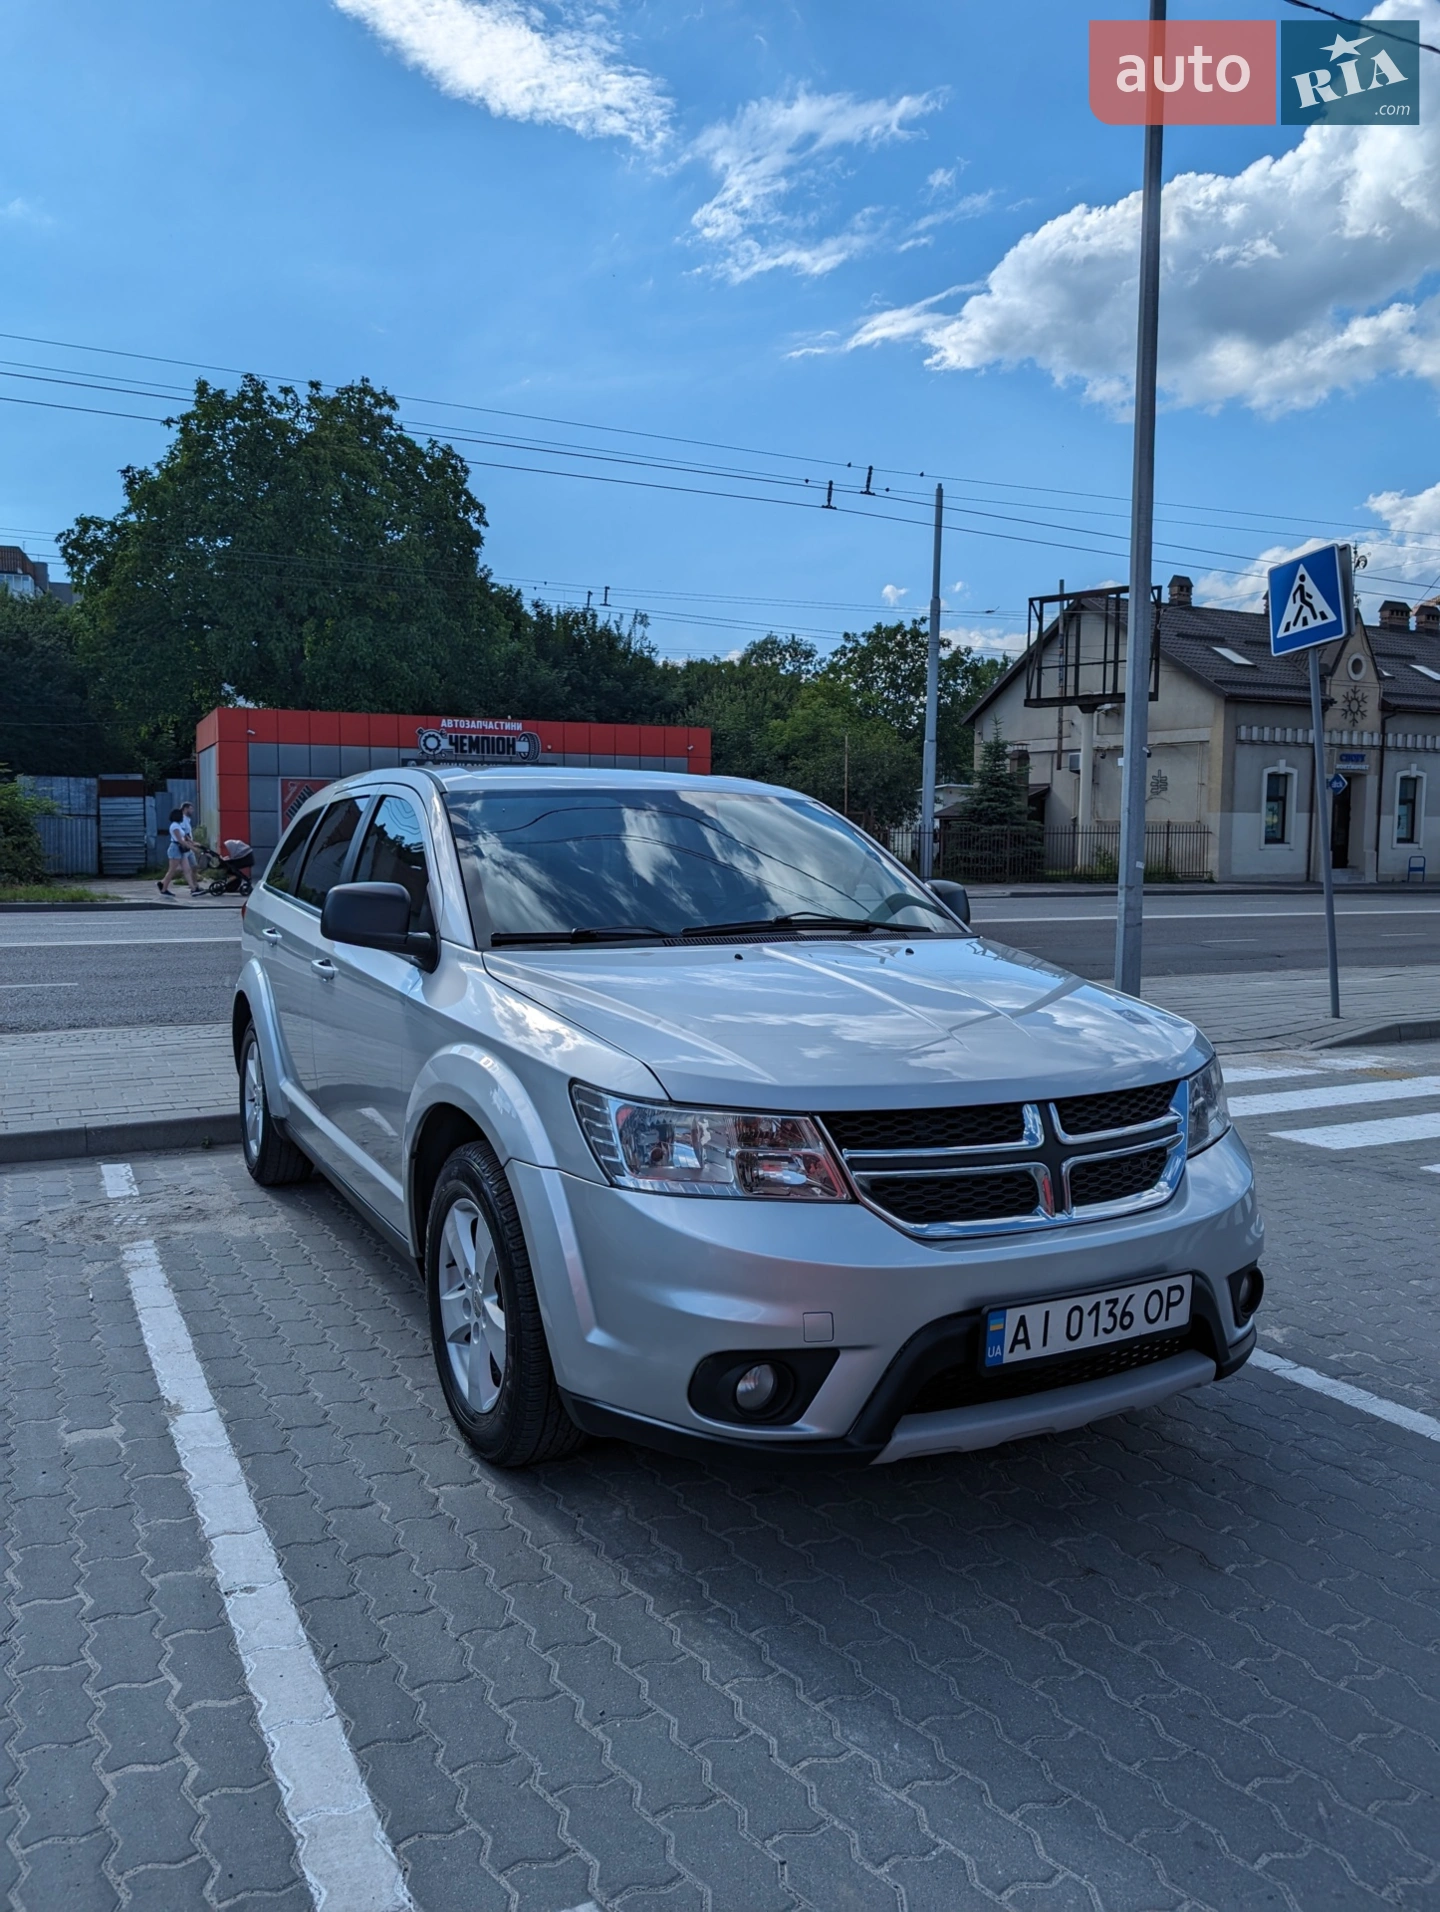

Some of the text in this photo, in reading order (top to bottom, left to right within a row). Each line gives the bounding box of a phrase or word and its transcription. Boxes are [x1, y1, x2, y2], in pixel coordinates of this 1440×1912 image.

[440, 718, 523, 731] АВТОЗАПЧАСТИНИ
[447, 733, 517, 756] ЧЕМПІОН
[1008, 1284, 1185, 1354] AI 0136 OP
[987, 1345, 1002, 1358] UA
